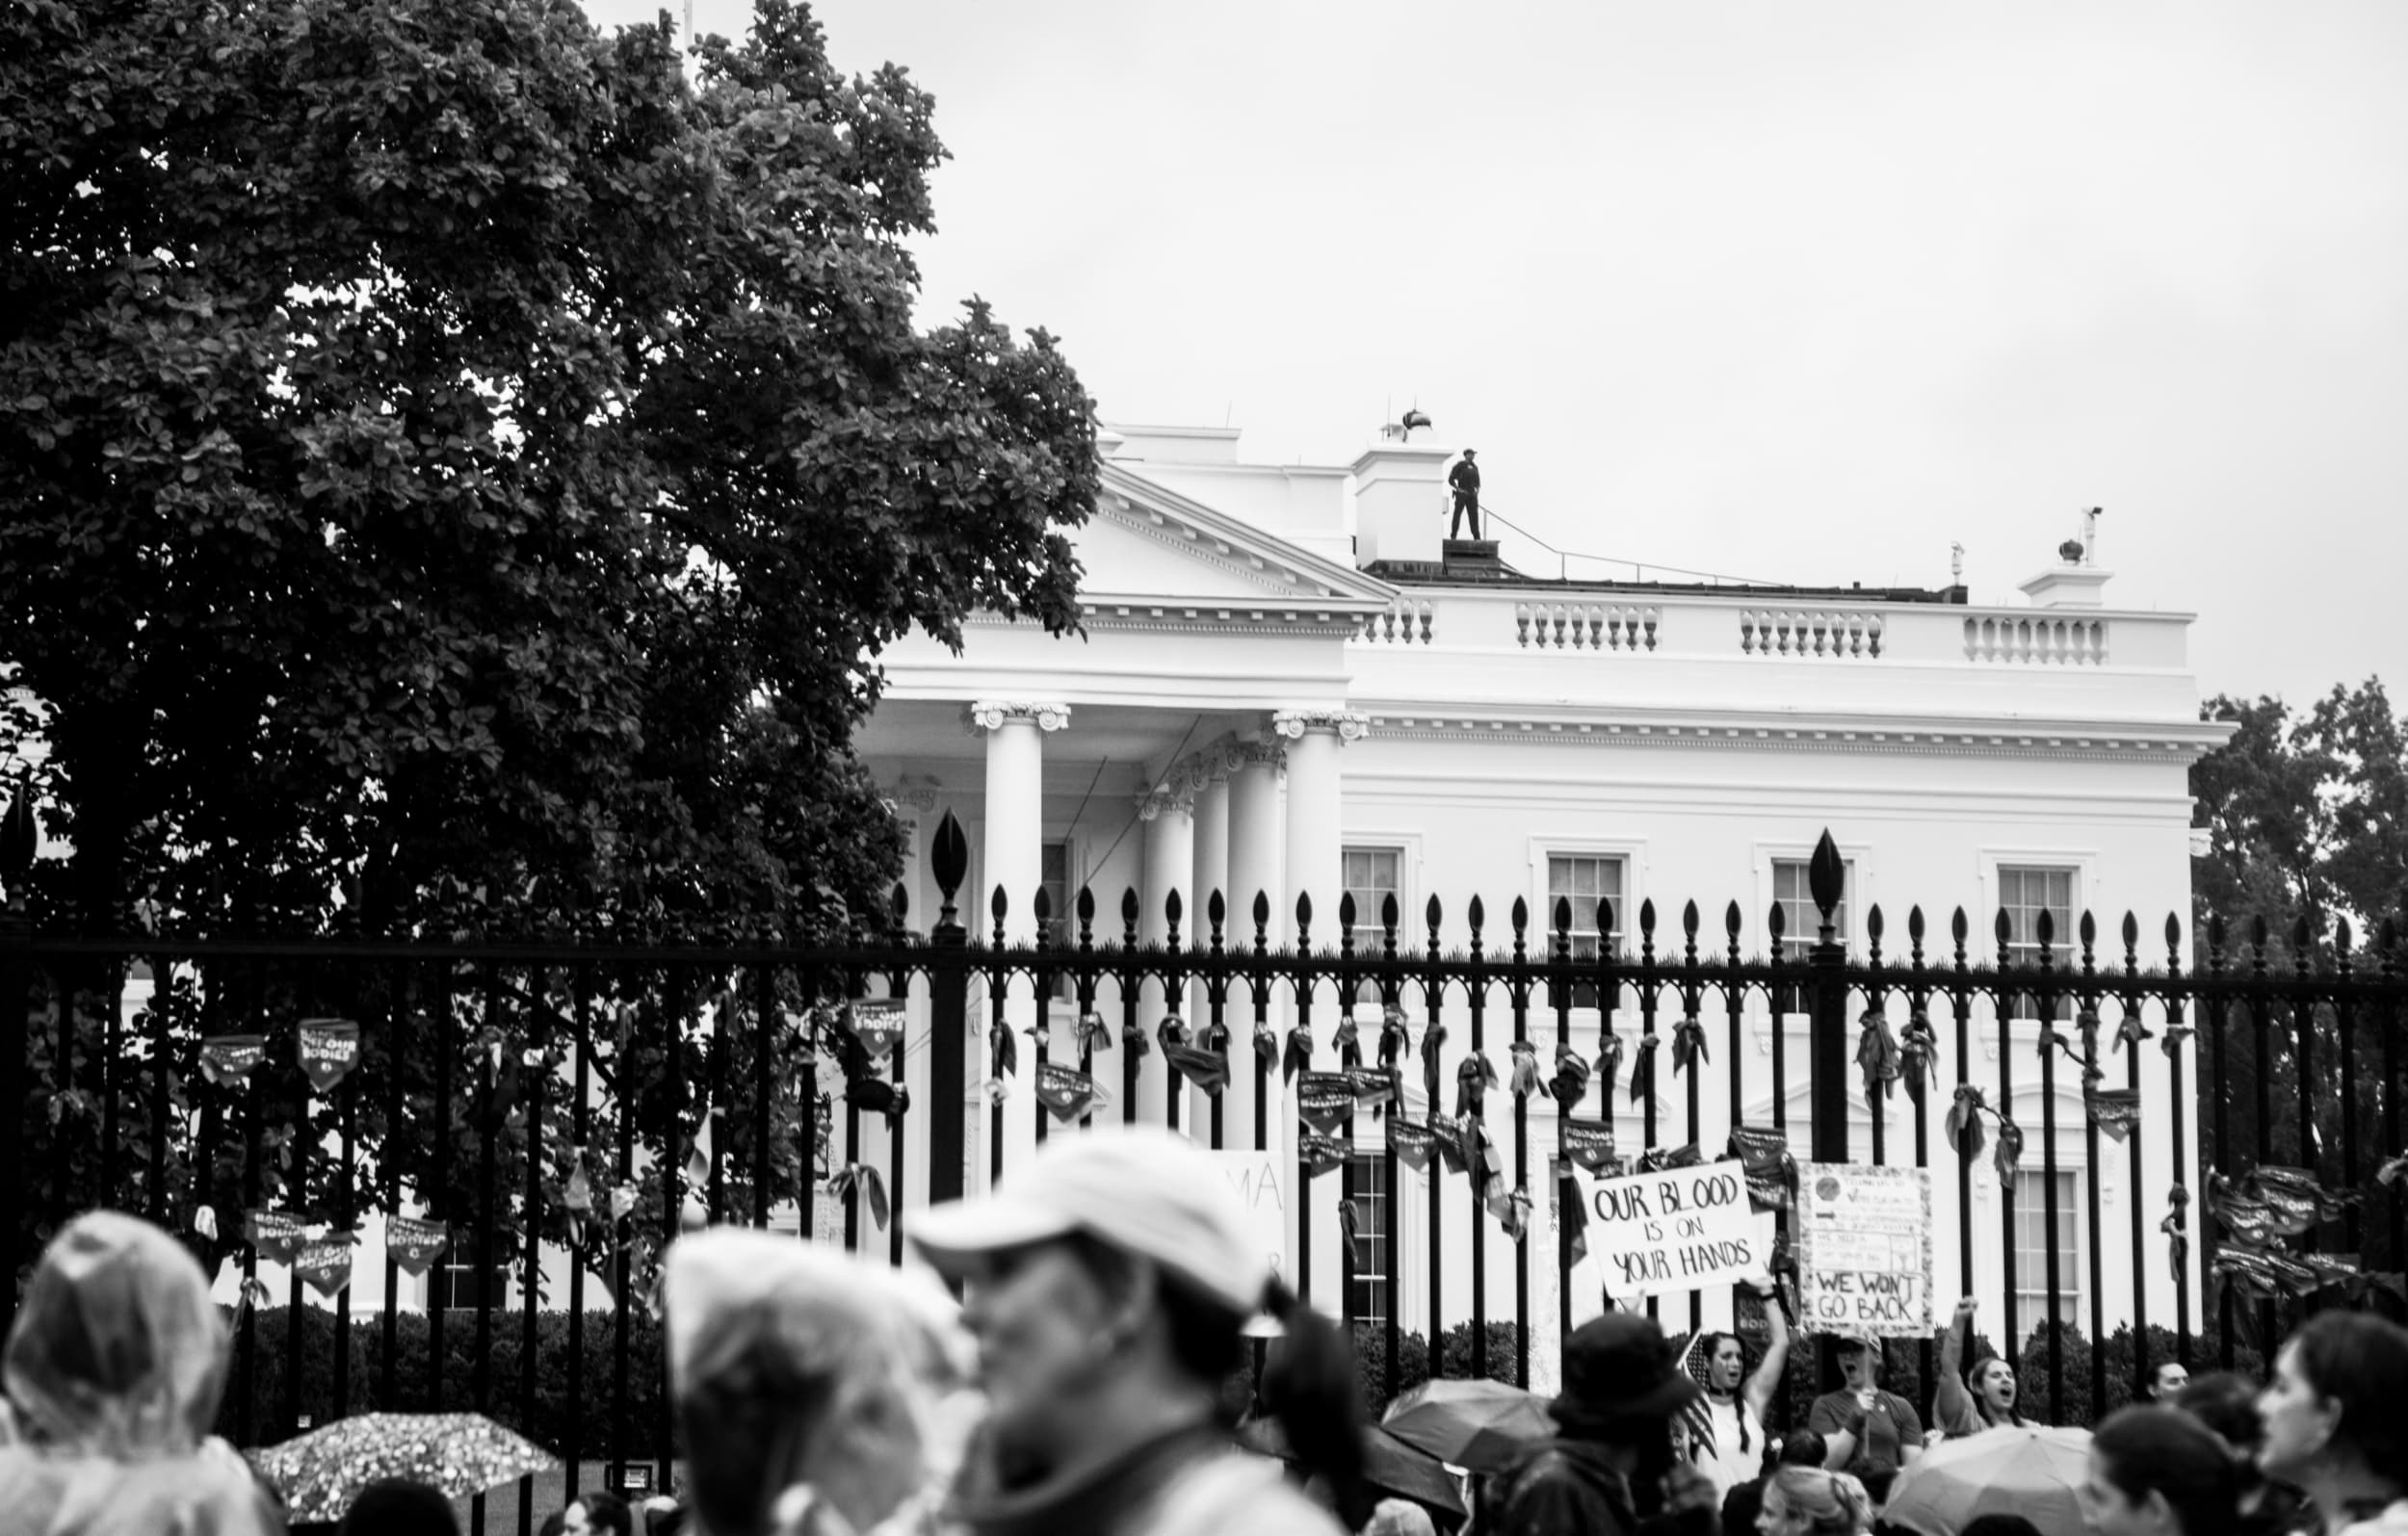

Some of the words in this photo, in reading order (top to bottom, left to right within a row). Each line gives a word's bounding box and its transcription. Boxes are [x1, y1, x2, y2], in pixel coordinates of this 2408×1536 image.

[302, 1048, 350, 1061] BODIES
[326, 1039, 356, 1052] OUR
[1594, 1185, 1652, 1221] OUR
[1658, 1174, 1738, 1215] BLOOD
[1643, 1220, 1663, 1241] IS
[1676, 1216, 1705, 1237] ON
[1612, 1249, 1672, 1284] YOUR
[1678, 1237, 1752, 1276] HANDS
[1816, 1271, 1855, 1293] WE
[1819, 1294, 1847, 1318] GO
[1857, 1295, 1913, 1322] BACK
